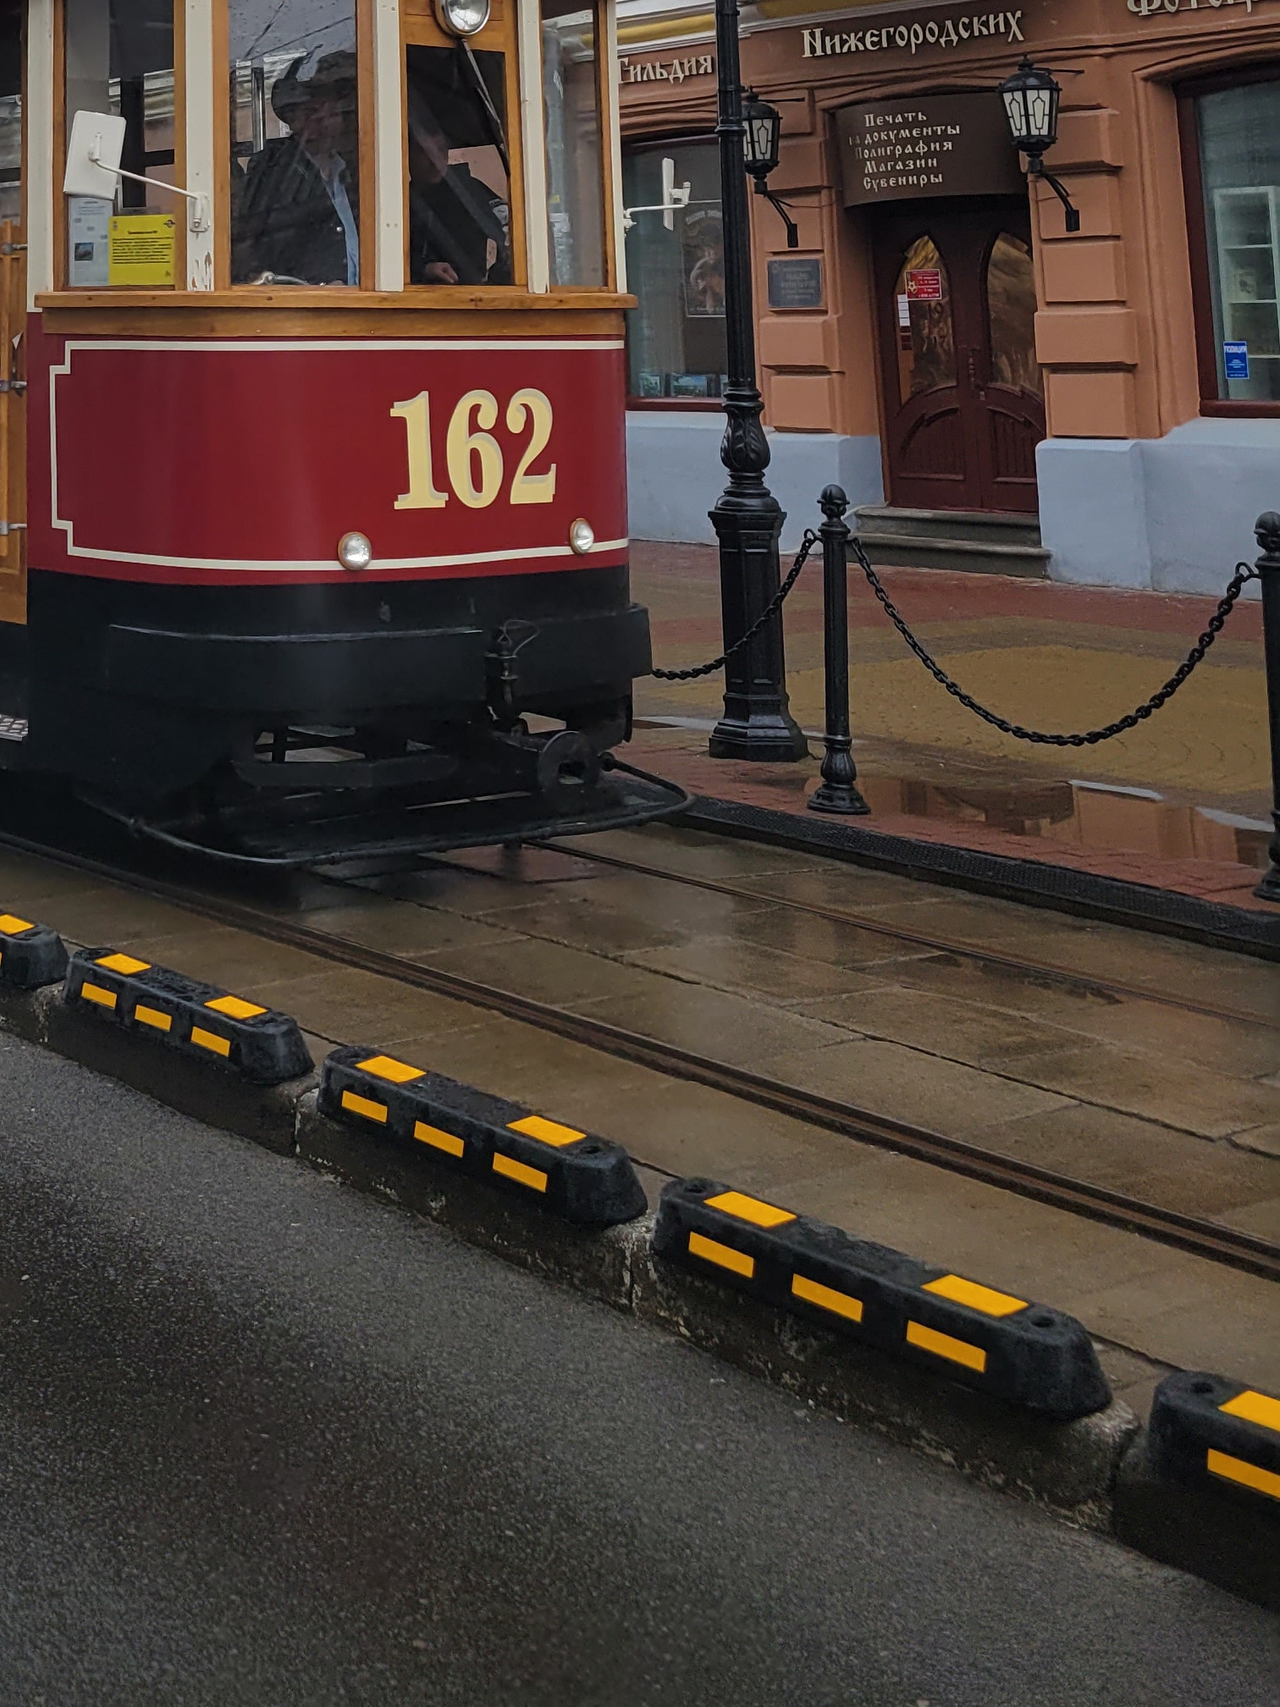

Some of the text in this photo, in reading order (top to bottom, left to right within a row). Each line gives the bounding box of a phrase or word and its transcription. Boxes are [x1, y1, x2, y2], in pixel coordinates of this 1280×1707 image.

[618, 54, 713, 84] Гильдия
[801, 10, 1025, 58] Нижегородских
[864, 112, 928, 127] Печать
[864, 125, 961, 145] документы
[855, 140, 953, 160] Полиграфия
[864, 157, 938, 174] Магазин
[863, 173, 943, 192] Сувениры
[390, 388, 557, 510] 162
